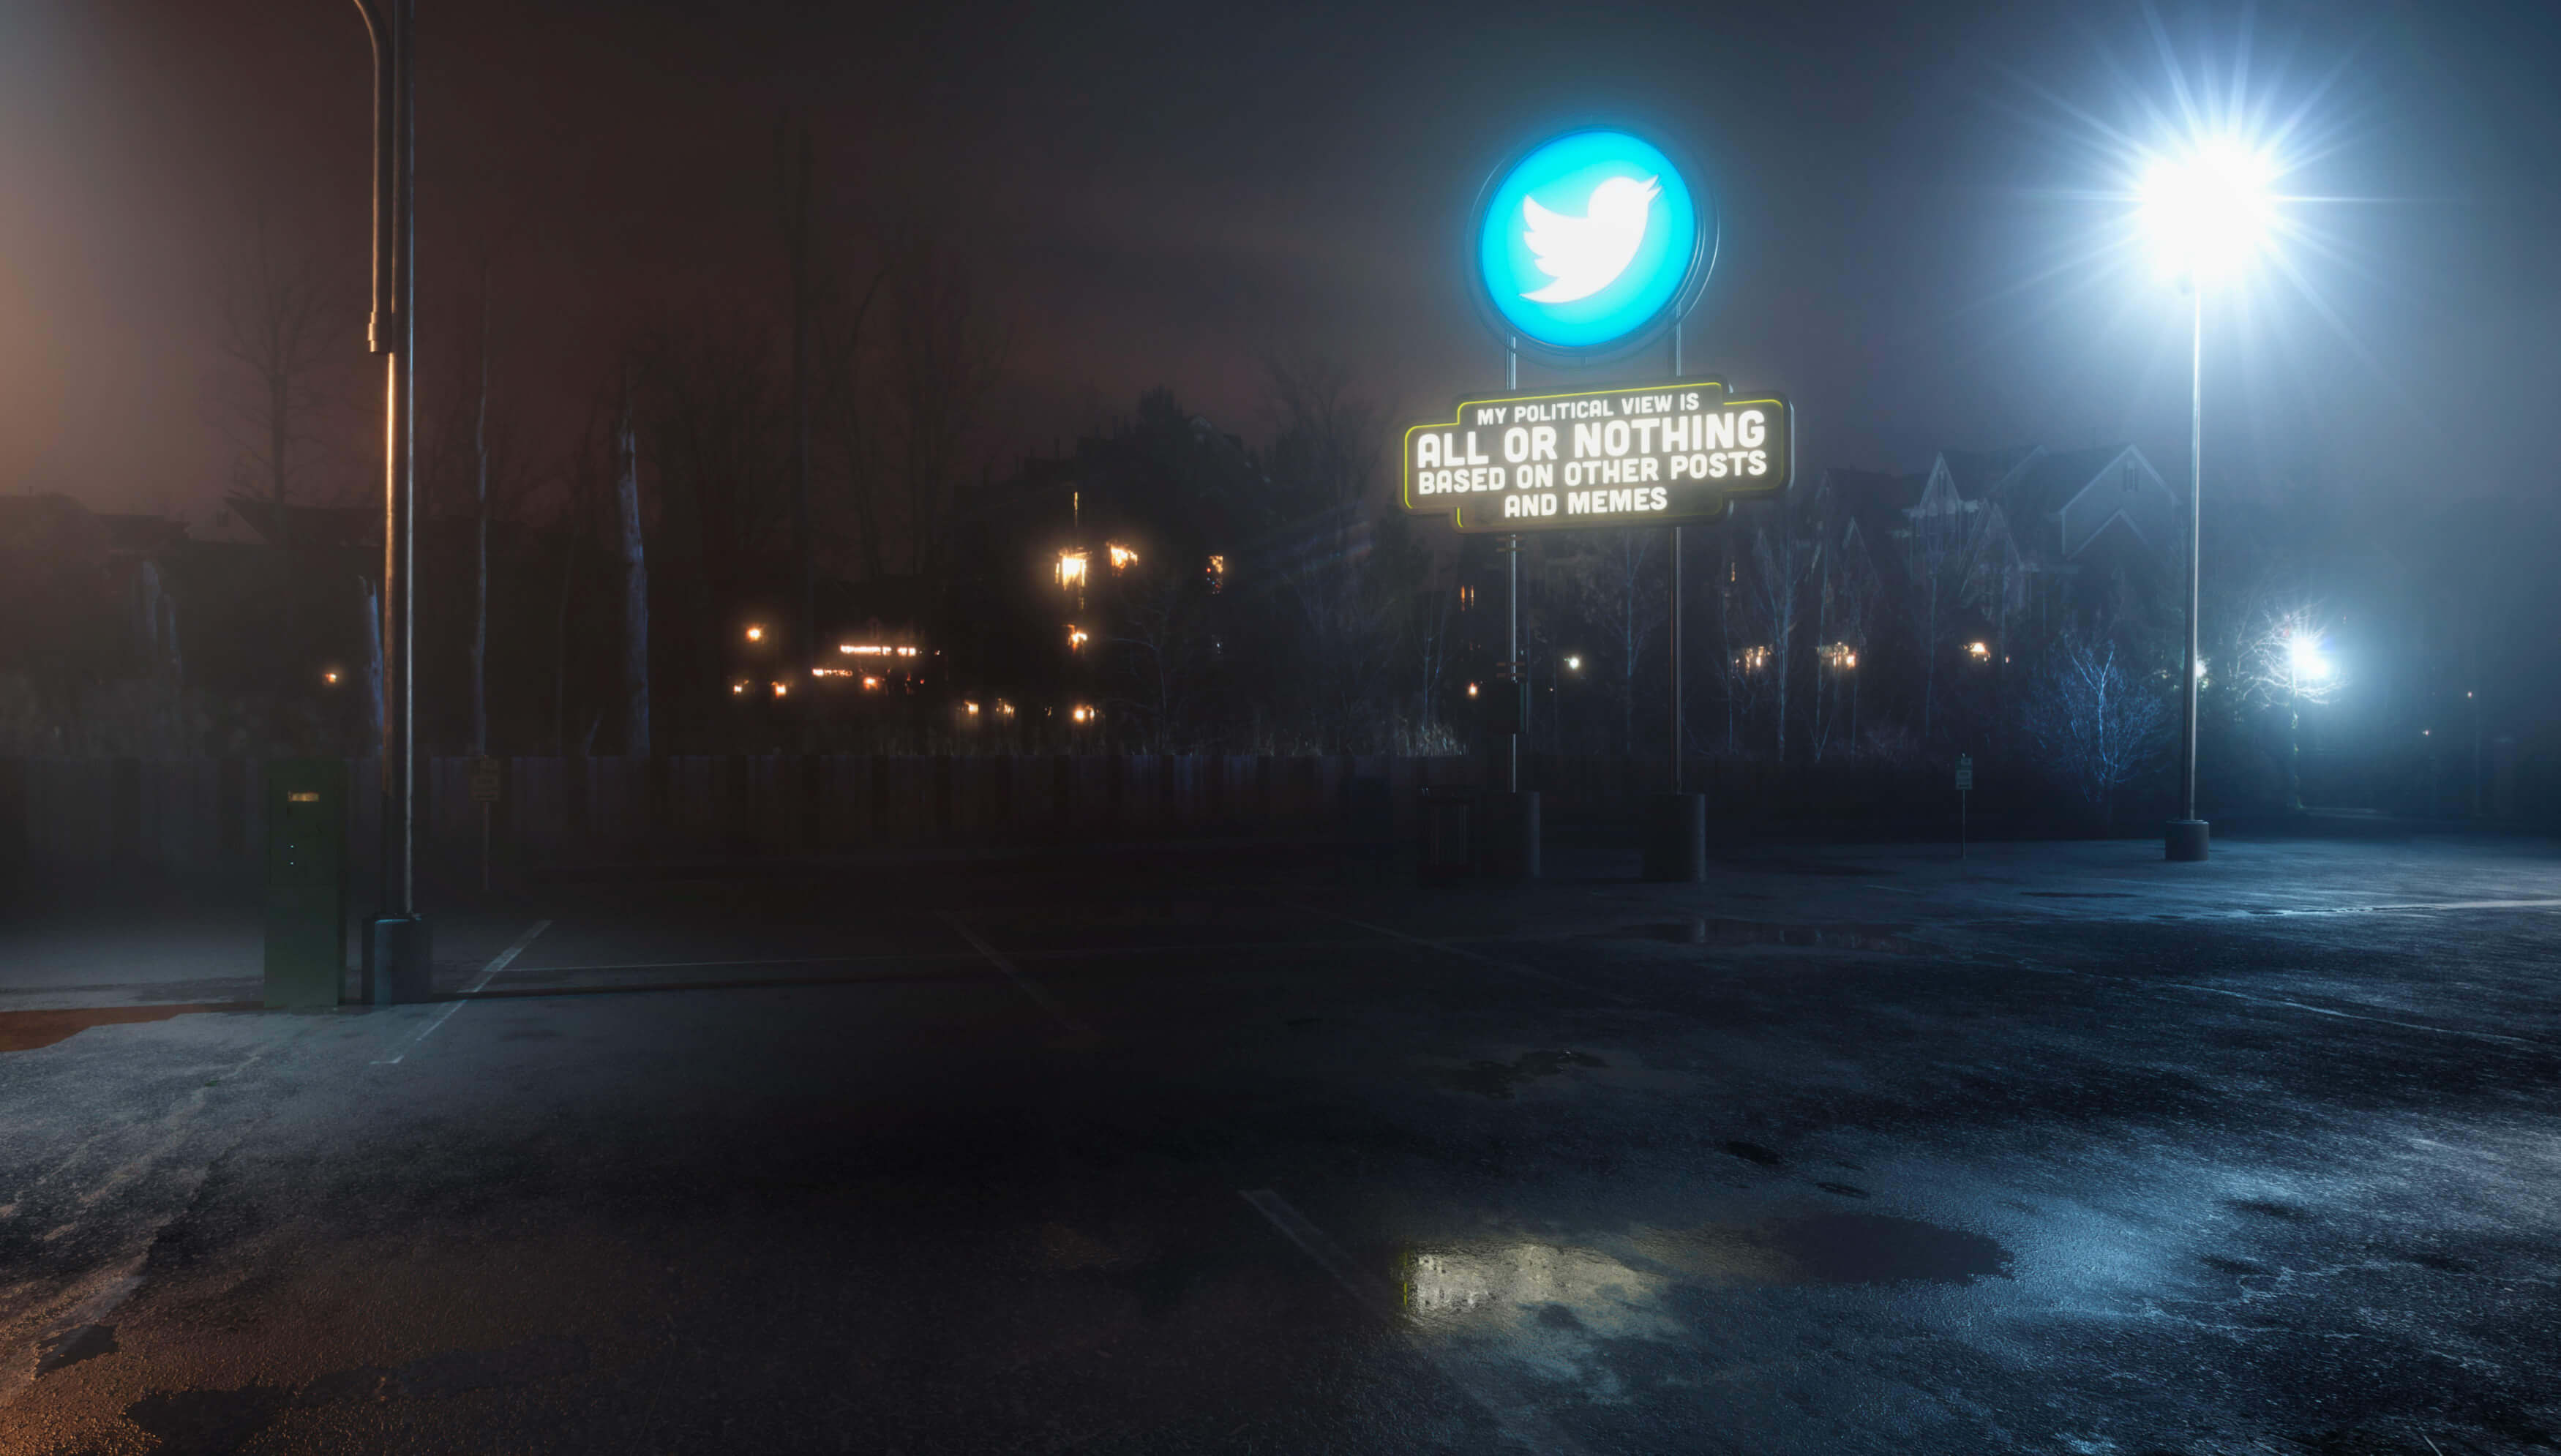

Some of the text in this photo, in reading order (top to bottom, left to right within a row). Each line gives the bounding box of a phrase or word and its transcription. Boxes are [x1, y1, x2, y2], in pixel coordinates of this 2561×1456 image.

[1477, 393, 1699, 426] MY POLITICAL VIEW IS
[1417, 410, 1766, 468] ALL OR NOTHING
[1419, 450, 1767, 495] BASED ON OTHER POSTS
[1504, 487, 1668, 518] AND MEMES
